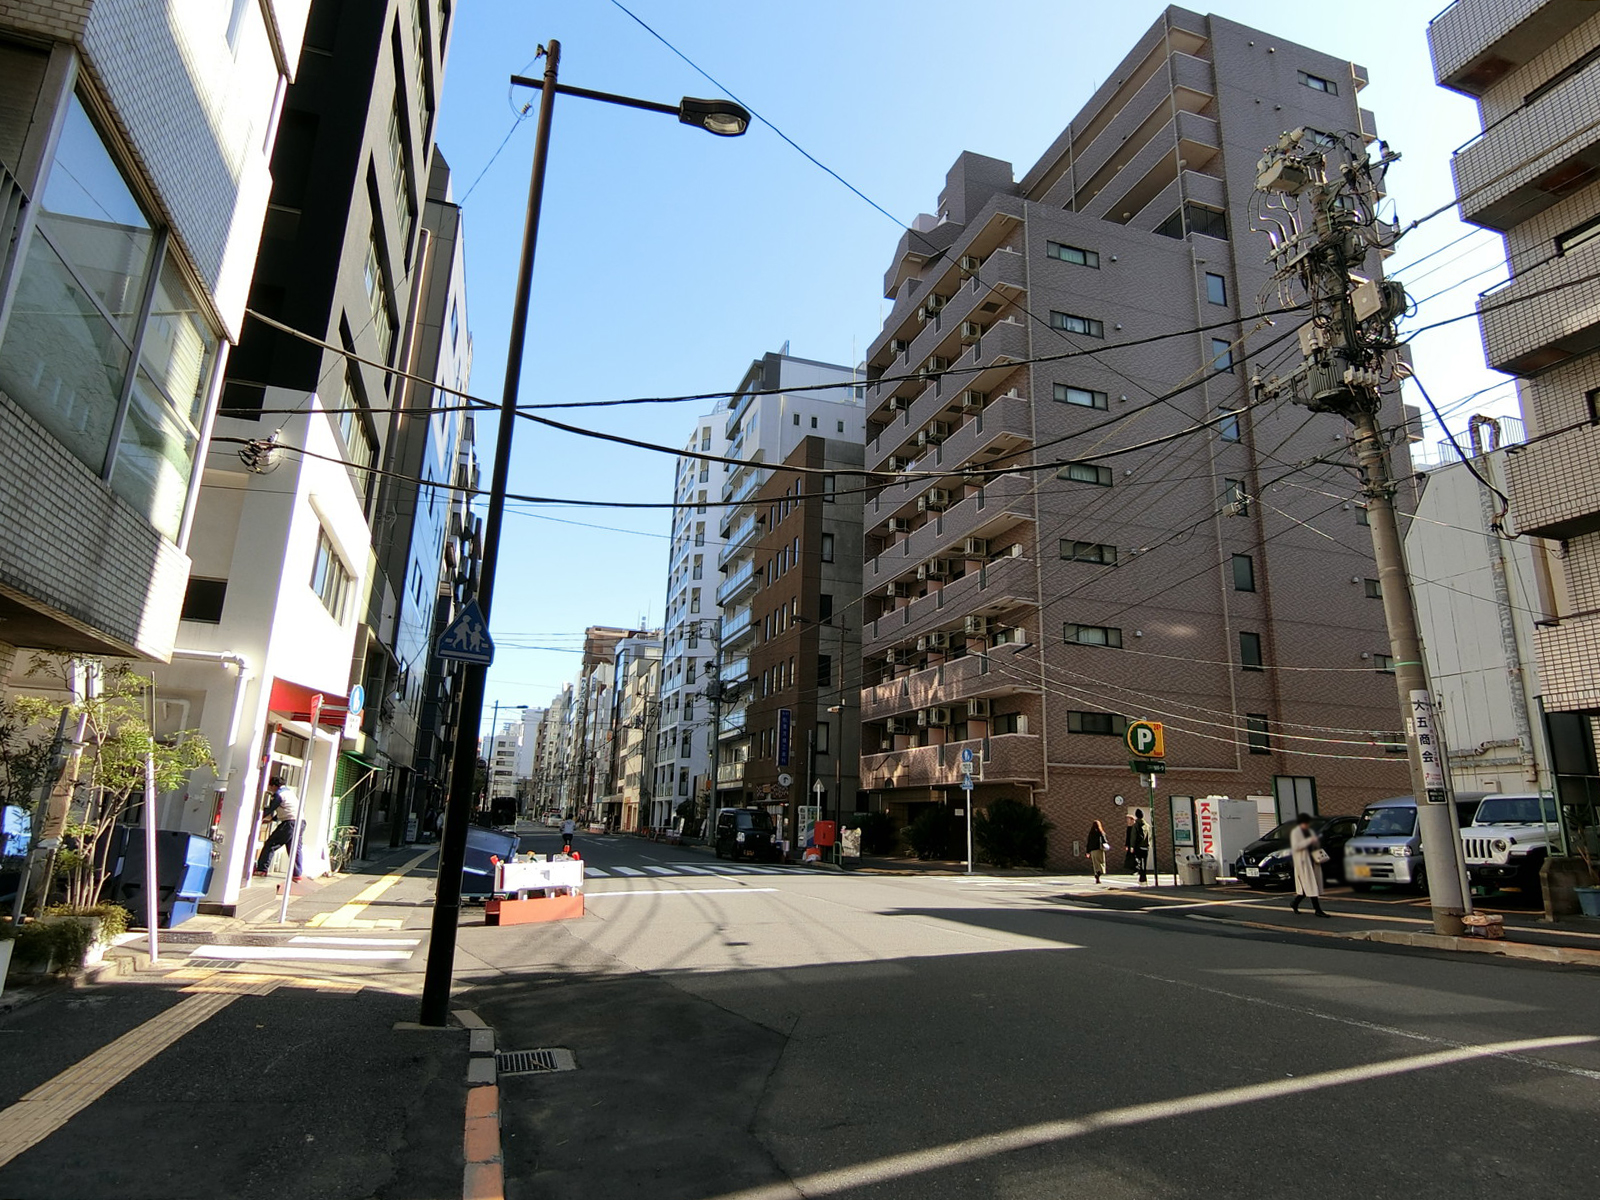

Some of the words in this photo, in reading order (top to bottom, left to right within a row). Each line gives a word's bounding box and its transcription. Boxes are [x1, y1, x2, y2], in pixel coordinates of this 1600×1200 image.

[1137, 727, 1152, 750] P
[1413, 700, 1434, 763] 大五商会
[1200, 802, 1213, 853] KIRIN
